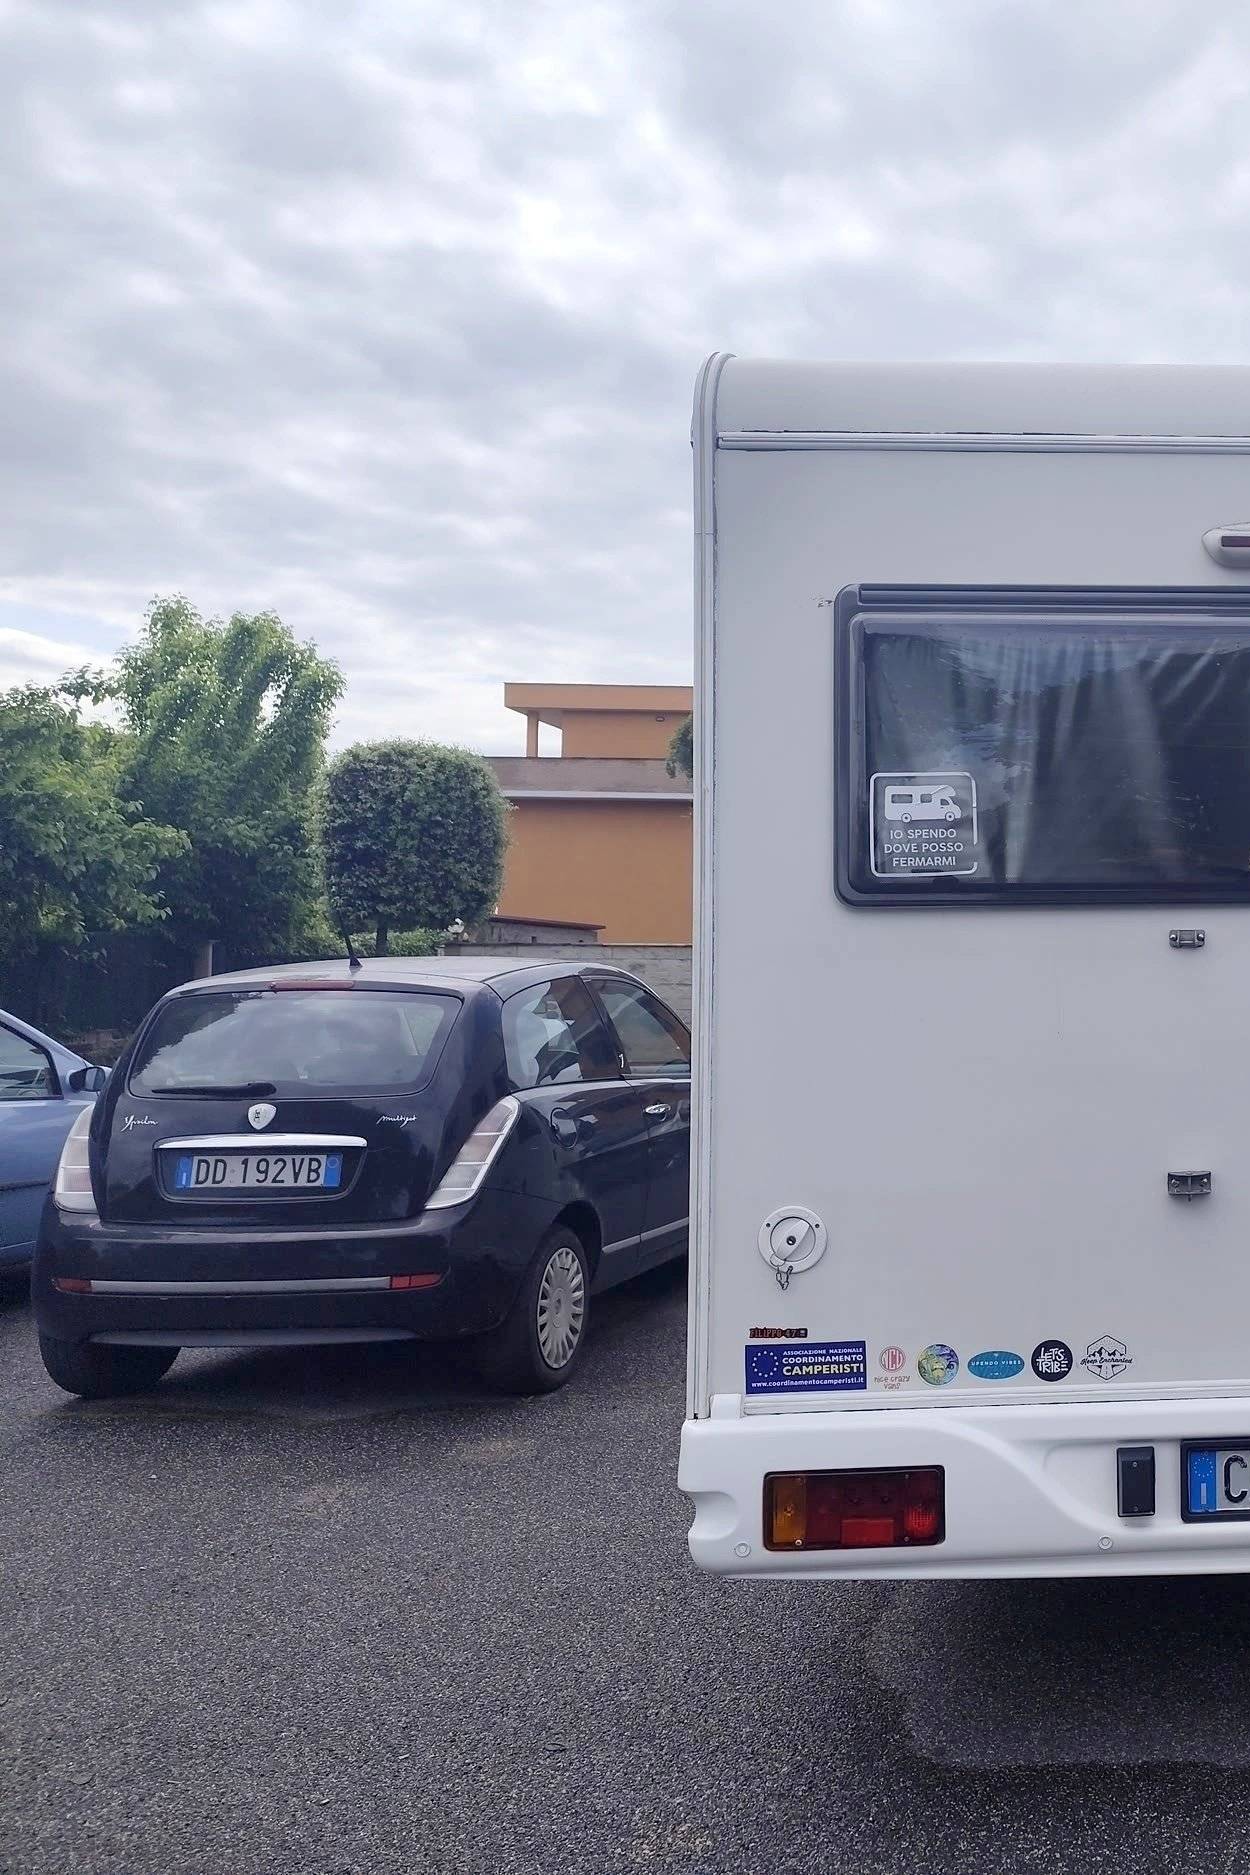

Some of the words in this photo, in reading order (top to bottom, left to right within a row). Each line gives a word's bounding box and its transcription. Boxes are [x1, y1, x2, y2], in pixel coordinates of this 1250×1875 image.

[890, 829, 903, 839] IO
[907, 828, 957, 839] SPENDO
[884, 843, 918, 853] DOVE
[922, 842, 964, 853] POSSO
[892, 856, 956, 867] FERMARMI
[194, 1158, 227, 1185] DD
[240, 1157, 322, 1185] 192VB
[782, 1354, 864, 1364] COORDINAMENTO
[782, 1363, 864, 1376] CAMPERISTI
[1036, 1357, 1069, 1373] TRIBE
[751, 1377, 864, 1387] www.coordinamentocamperisti.it
